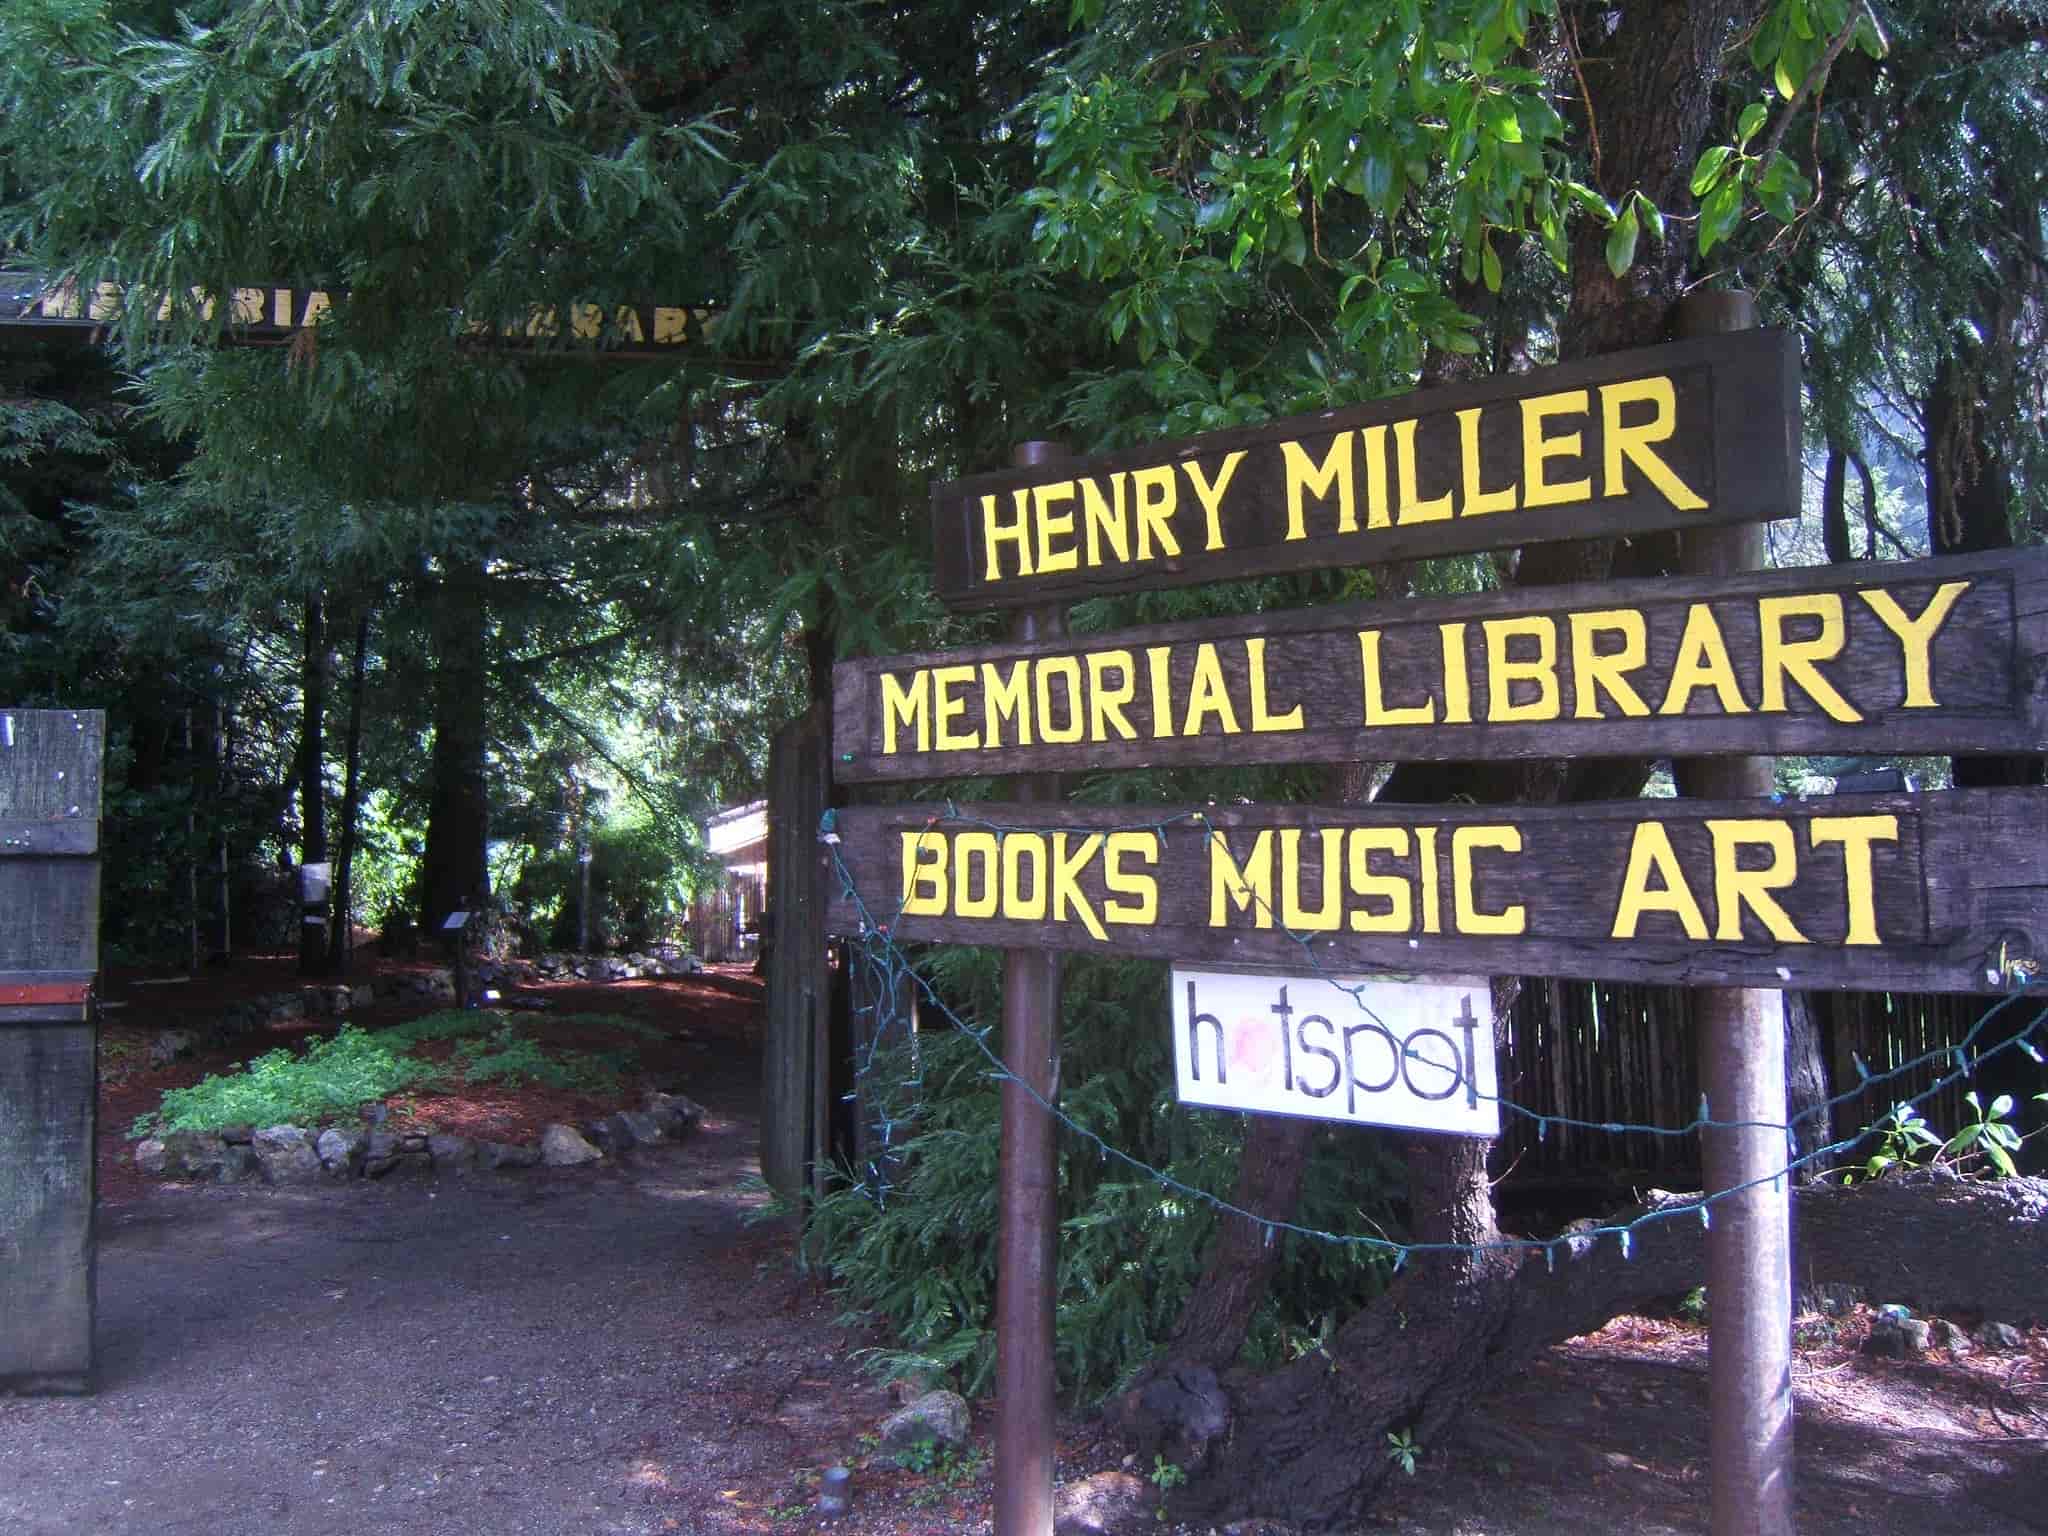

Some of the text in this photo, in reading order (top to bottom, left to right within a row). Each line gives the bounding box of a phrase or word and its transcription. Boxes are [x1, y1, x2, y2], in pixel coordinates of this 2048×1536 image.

[982, 375, 1709, 582] HENRY MILLER
[879, 580, 1971, 755] MEMORIAL LIBRARY
[900, 814, 1900, 947] BOOKS MUSIC ART
